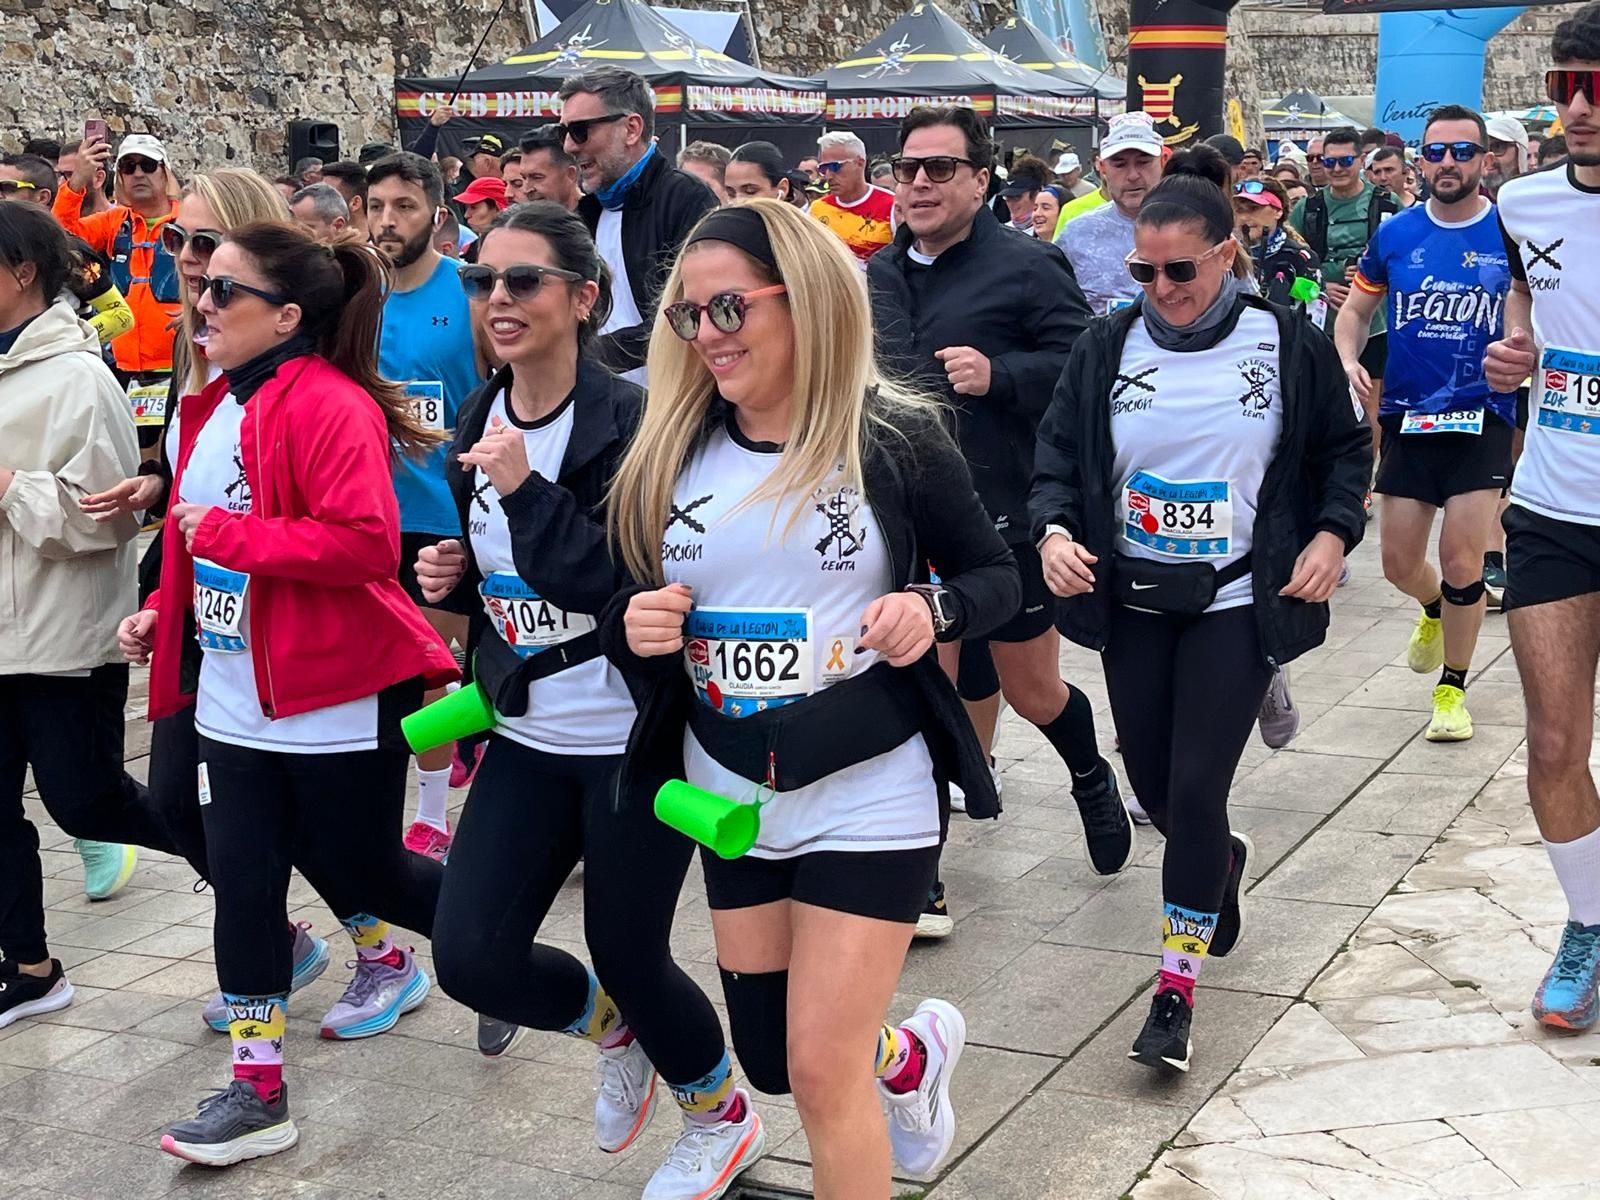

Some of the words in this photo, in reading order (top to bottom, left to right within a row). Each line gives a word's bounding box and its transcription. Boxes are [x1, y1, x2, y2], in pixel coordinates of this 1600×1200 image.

[496, 91, 564, 117] DEPO
[1395, 285, 1503, 336] LEGIÓN
[1129, 510, 1142, 525] 20
[1163, 503, 1214, 529] 834
[661, 539, 702, 562] EDICIÓN
[821, 560, 855, 571] CEUTA
[199, 587, 236, 626] 1246
[715, 641, 799, 682] 1662
[729, 682, 754, 690] CLAUDIA
